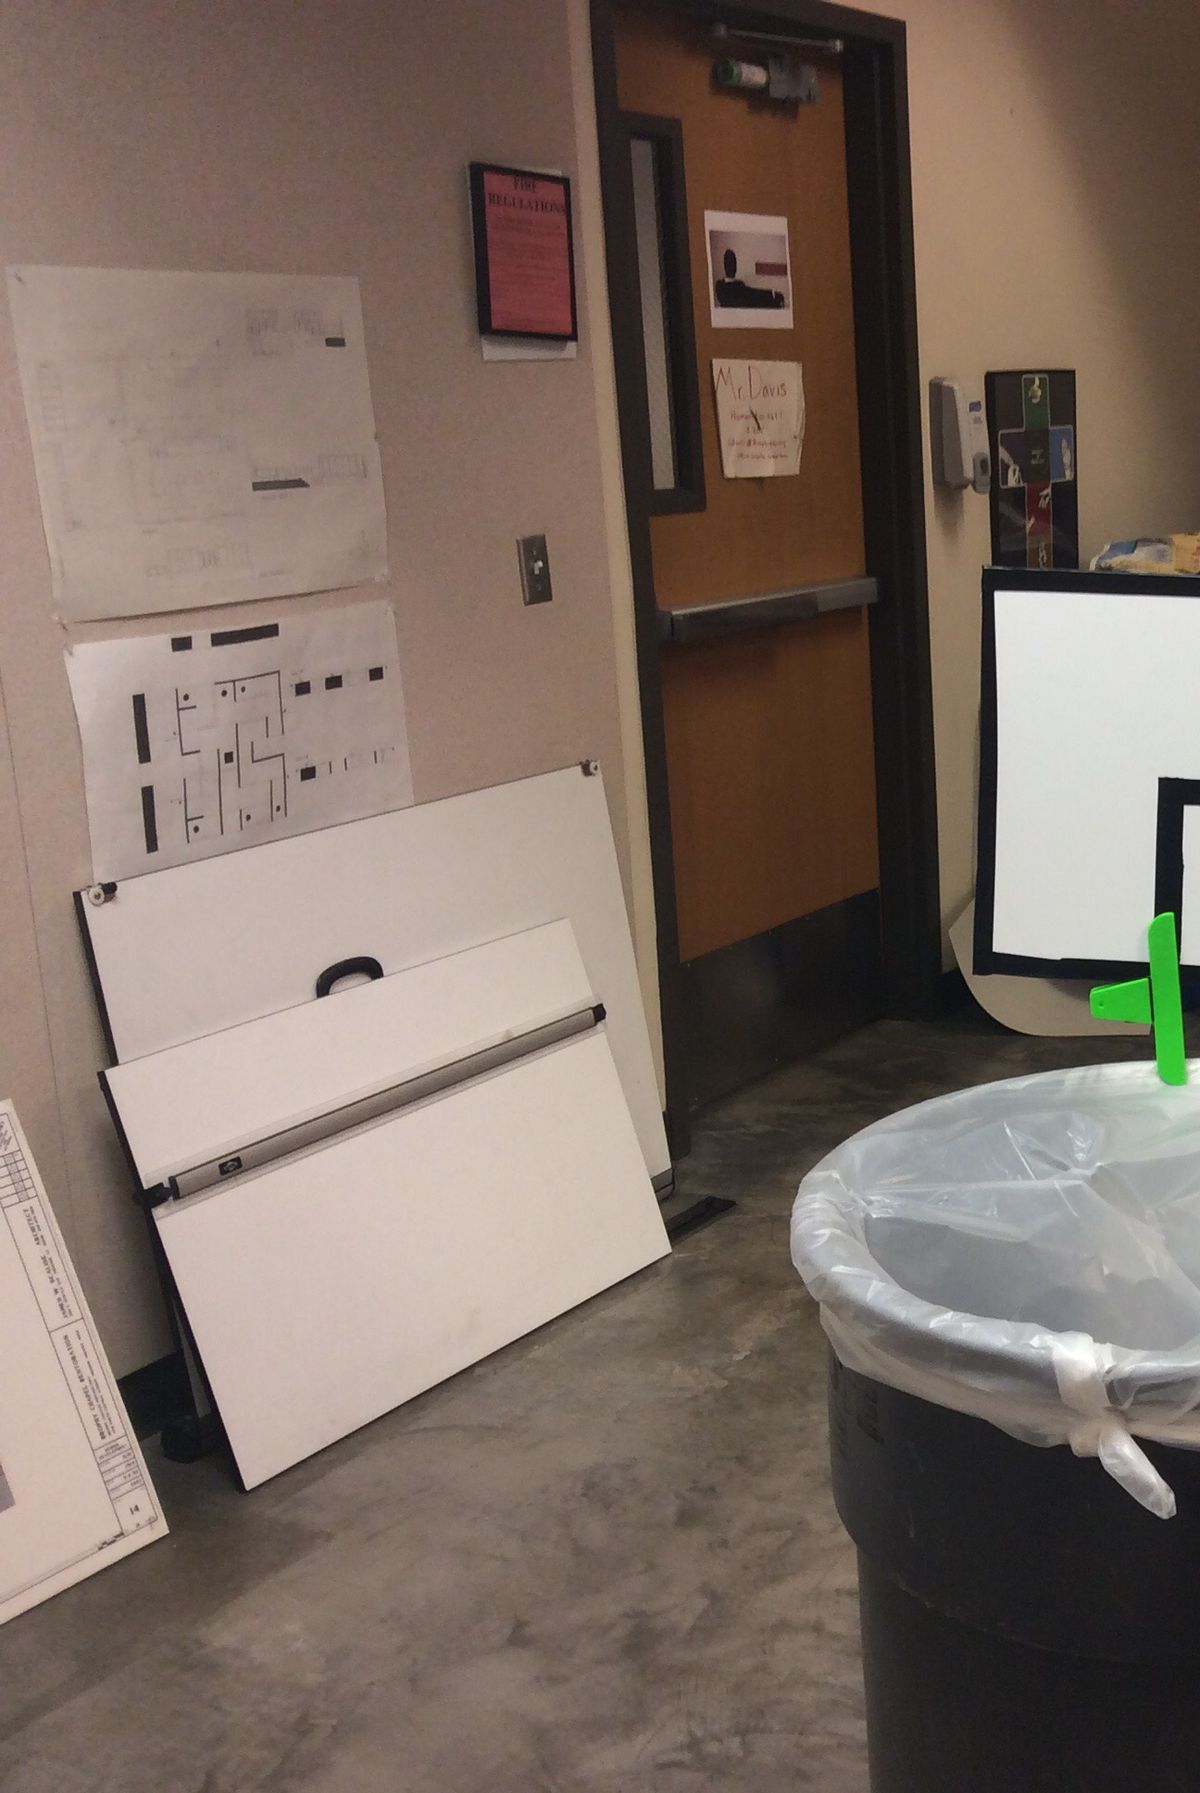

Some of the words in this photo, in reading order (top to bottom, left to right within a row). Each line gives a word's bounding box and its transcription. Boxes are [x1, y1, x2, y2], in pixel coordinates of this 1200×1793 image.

[513, 176, 536, 193] FIRE
[488, 192, 566, 213] REGULATIONS
[748, 365, 787, 400] Davis
